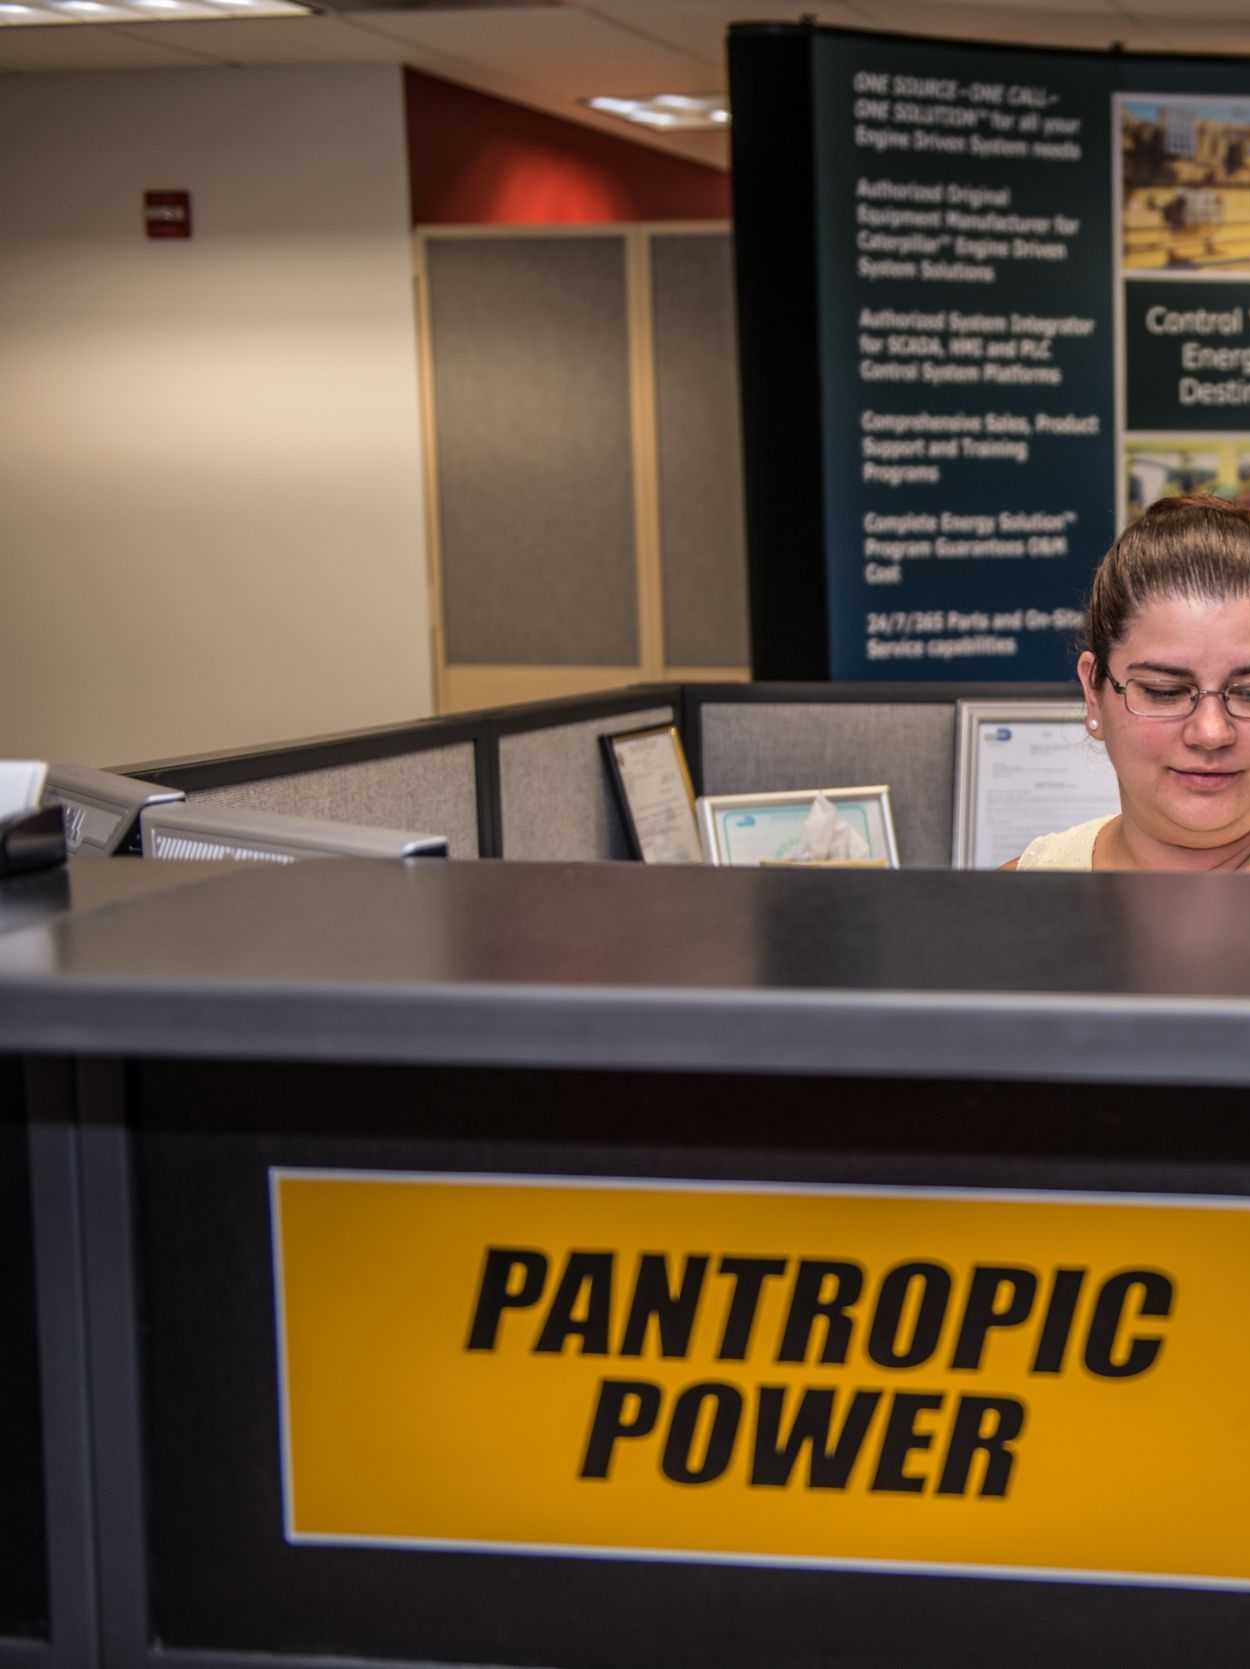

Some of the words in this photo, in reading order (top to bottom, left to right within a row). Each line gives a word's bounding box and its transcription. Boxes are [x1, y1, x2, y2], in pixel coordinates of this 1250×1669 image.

[854, 71, 889, 93] ONE
[893, 75, 957, 99] SOURCE
[969, 83, 1003, 103] ONE
[1007, 86, 1048, 107] CALL
[854, 99, 889, 120] ONE
[991, 111, 1015, 130] for
[1019, 113, 1042, 131] all
[1044, 118, 1080, 135] your
[855, 125, 909, 152] Engine
[914, 130, 965, 151] Driven
[970, 135, 1028, 159] System
[1033, 142, 1081, 161] needs
[857, 178, 943, 202] Authorized
[947, 184, 1010, 209] Original
[857, 205, 942, 229] Equipment
[946, 211, 1050, 235] Manufacturer
[1055, 215, 1080, 235] for
[955, 237, 1009, 262] Engine
[1012, 239, 1067, 260] Driven
[858, 257, 917, 282] System
[921, 261, 995, 282] Solutions
[860, 308, 946, 331] Authorized
[949, 311, 1008, 333] System
[1011, 314, 1095, 337] Integrator
[1146, 306, 1243, 335] Control
[860, 334, 884, 354] for
[987, 340, 1017, 358] and
[1020, 338, 1052, 360] PLC
[860, 360, 918, 382] Control
[922, 362, 980, 386] System
[983, 364, 1062, 385] Platforms
[862, 410, 982, 434] Comprehensive
[1035, 413, 1099, 436] Product
[863, 437, 925, 459] Support
[928, 439, 959, 459] and
[962, 438, 1029, 463] Training
[863, 463, 940, 487] Programs
[864, 512, 937, 535] Complete
[940, 512, 995, 536] Energy
[864, 538, 932, 560] Program
[935, 537, 1025, 558] Guarantees
[865, 562, 901, 584] Cost
[867, 611, 944, 635] 24/7/365
[947, 611, 989, 630] Parts
[992, 611, 1022, 630] and
[867, 638, 924, 660] Service
[927, 634, 1016, 660] capabilities
[465, 1246, 1175, 1379] PANTROPIC
[577, 1379, 1028, 1499] POWER
